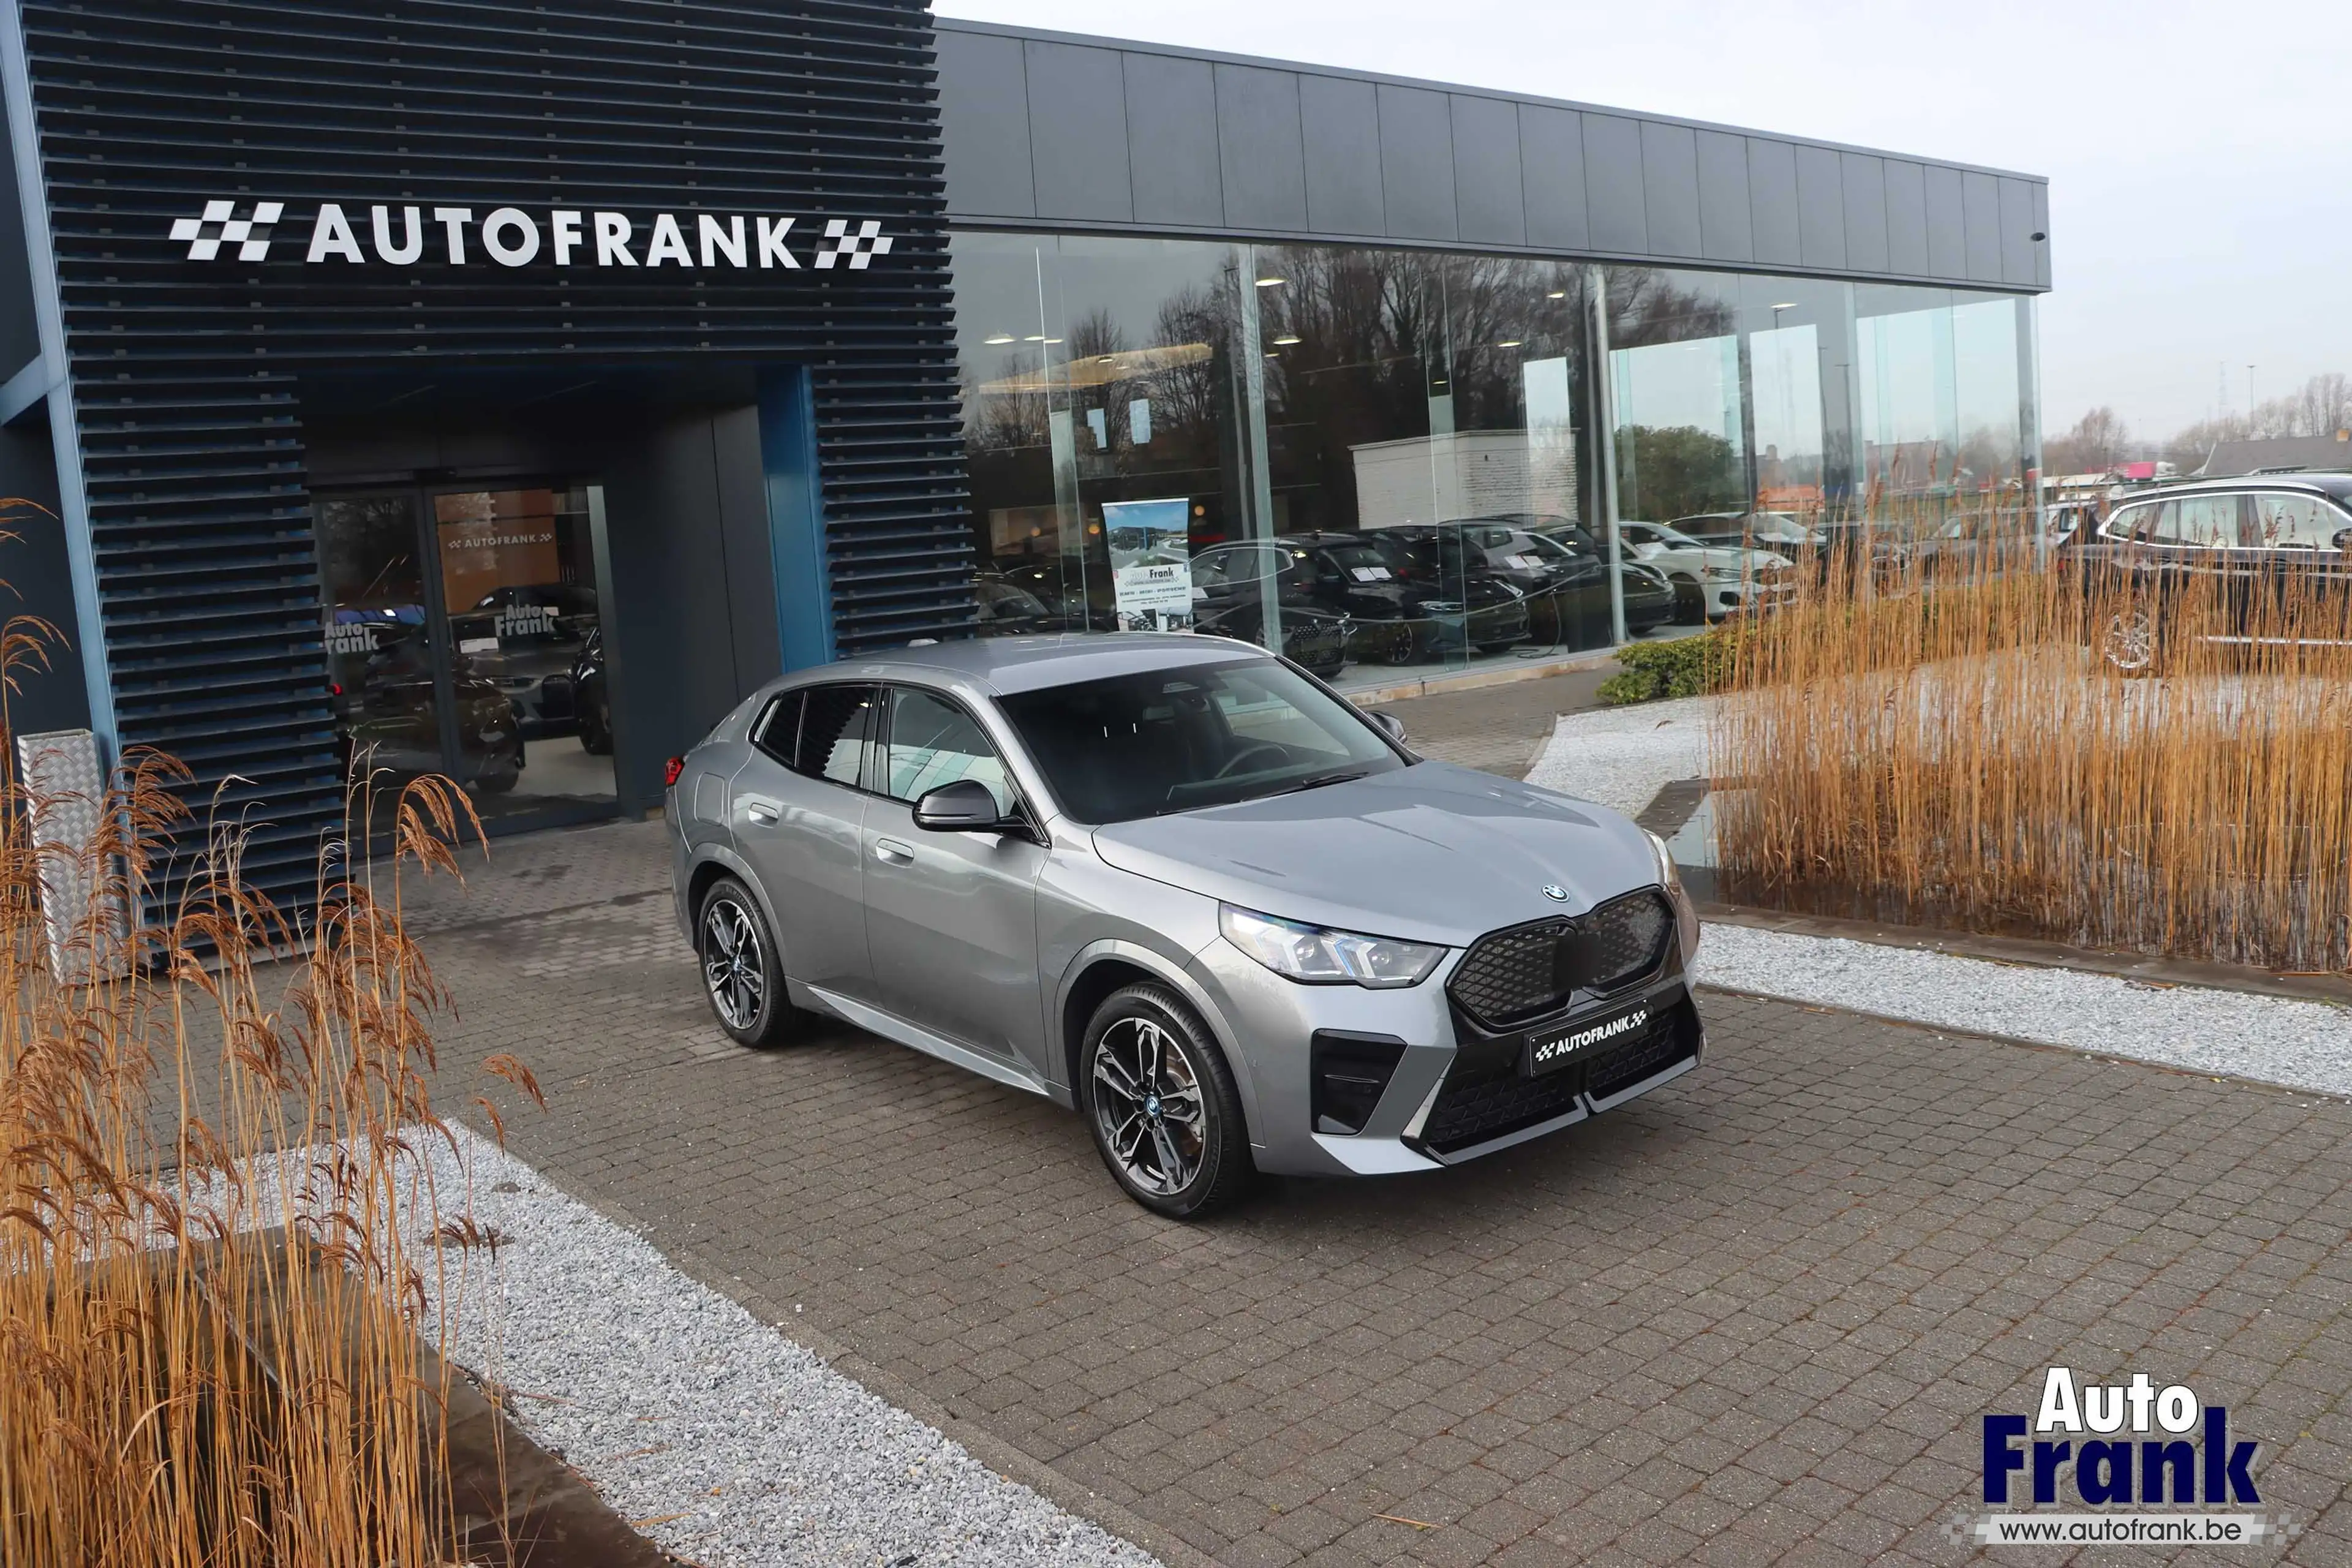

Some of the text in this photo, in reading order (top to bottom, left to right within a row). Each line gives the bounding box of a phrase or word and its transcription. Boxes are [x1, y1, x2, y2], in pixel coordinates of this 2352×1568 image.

[306, 203, 801, 268] AUTOFRANK
[464, 534, 537, 548] AUTOFRANK
[1150, 567, 1174, 578] Frank
[506, 603, 541, 620] Auto
[325, 621, 364, 639] Auto
[494, 611, 557, 637] Frank
[324, 627, 379, 655] rank
[1556, 1016, 1630, 1055] AUTOFRANK
